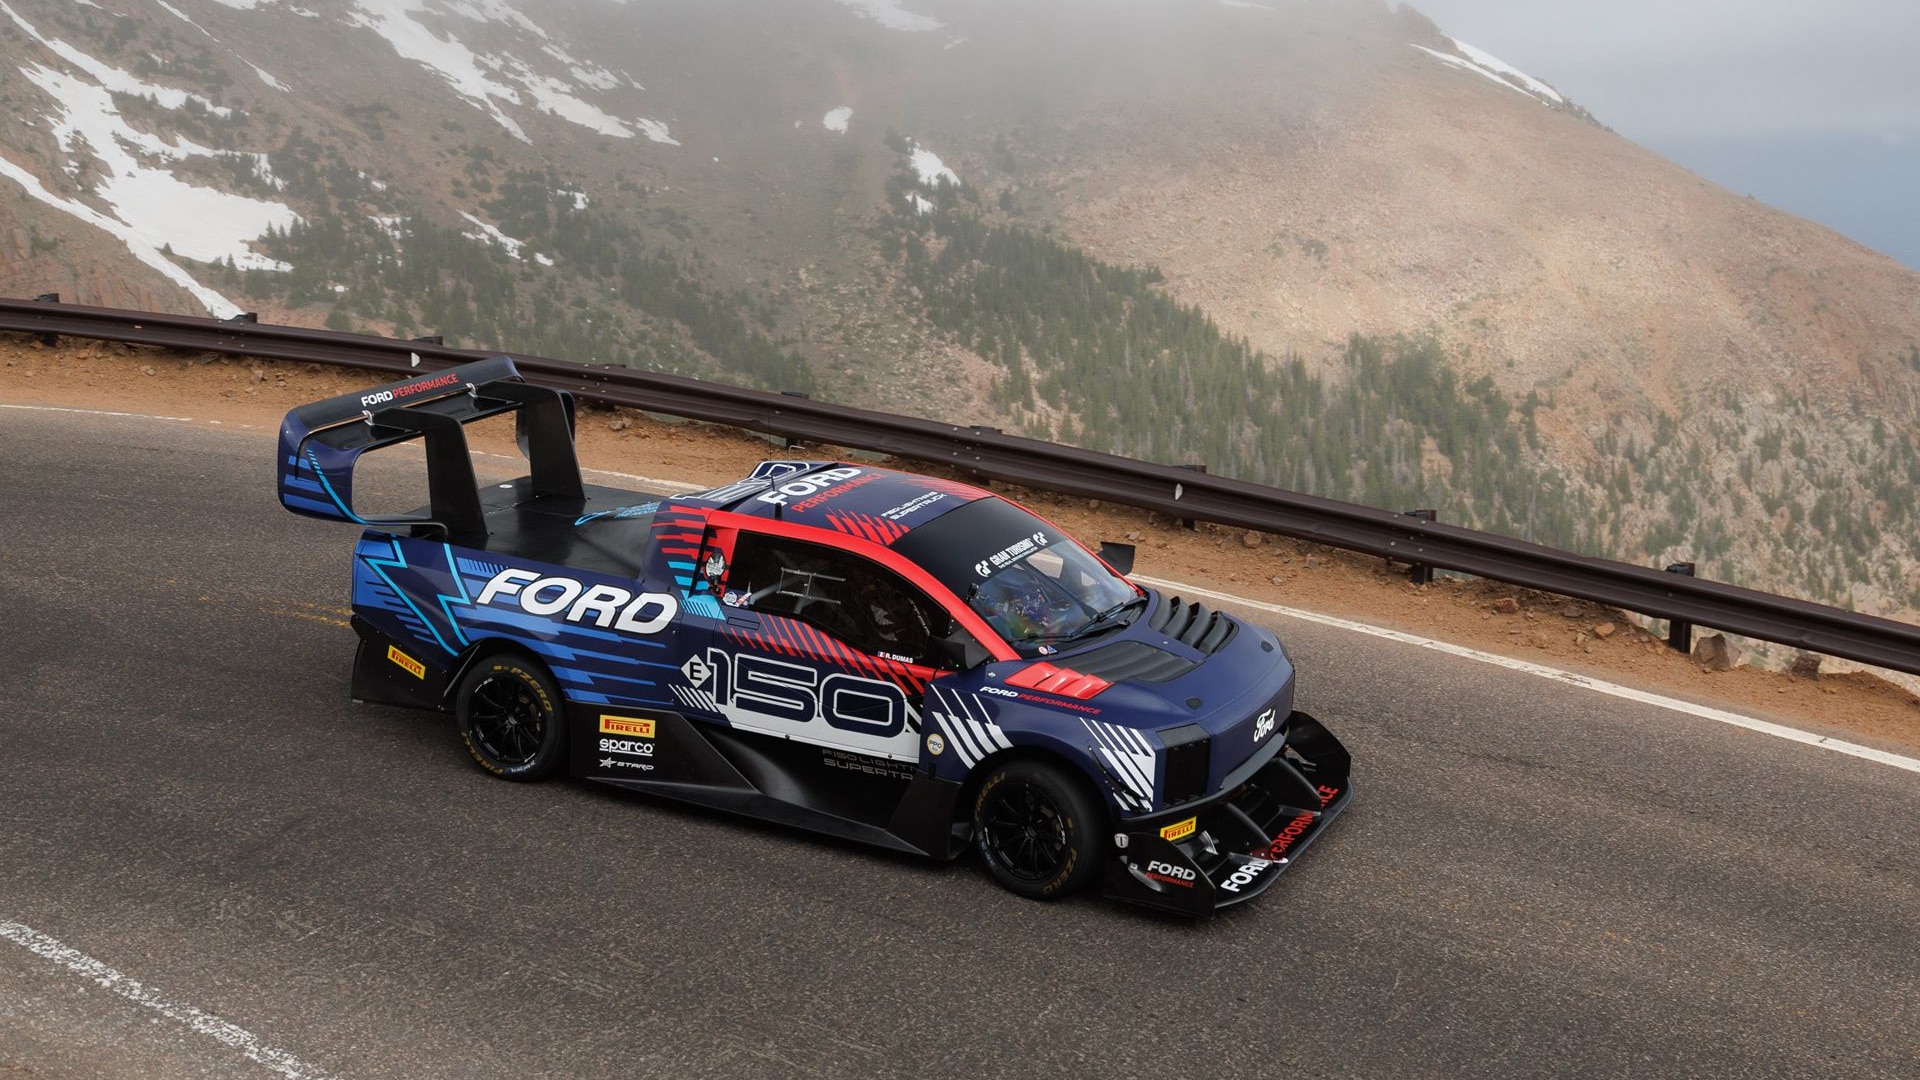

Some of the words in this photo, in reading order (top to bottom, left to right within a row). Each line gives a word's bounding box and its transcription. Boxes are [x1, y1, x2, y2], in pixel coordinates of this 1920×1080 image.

[757, 467, 862, 506] FORD
[791, 472, 888, 513] PERFORMANCE
[989, 550, 1011, 566] GRAN
[476, 568, 678, 634] FORD
[391, 649, 422, 675] PIRELLI
[892, 654, 914, 664] DUMAS
[707, 647, 908, 738] 150
[605, 719, 651, 734] PIRELLI
[1254, 709, 1275, 742] Ford
[599, 739, 653, 754] sparco
[1164, 820, 1194, 840] PIRELLI
[1144, 872, 1194, 888] PERFORMANCE
[1147, 860, 1196, 881] FORD
